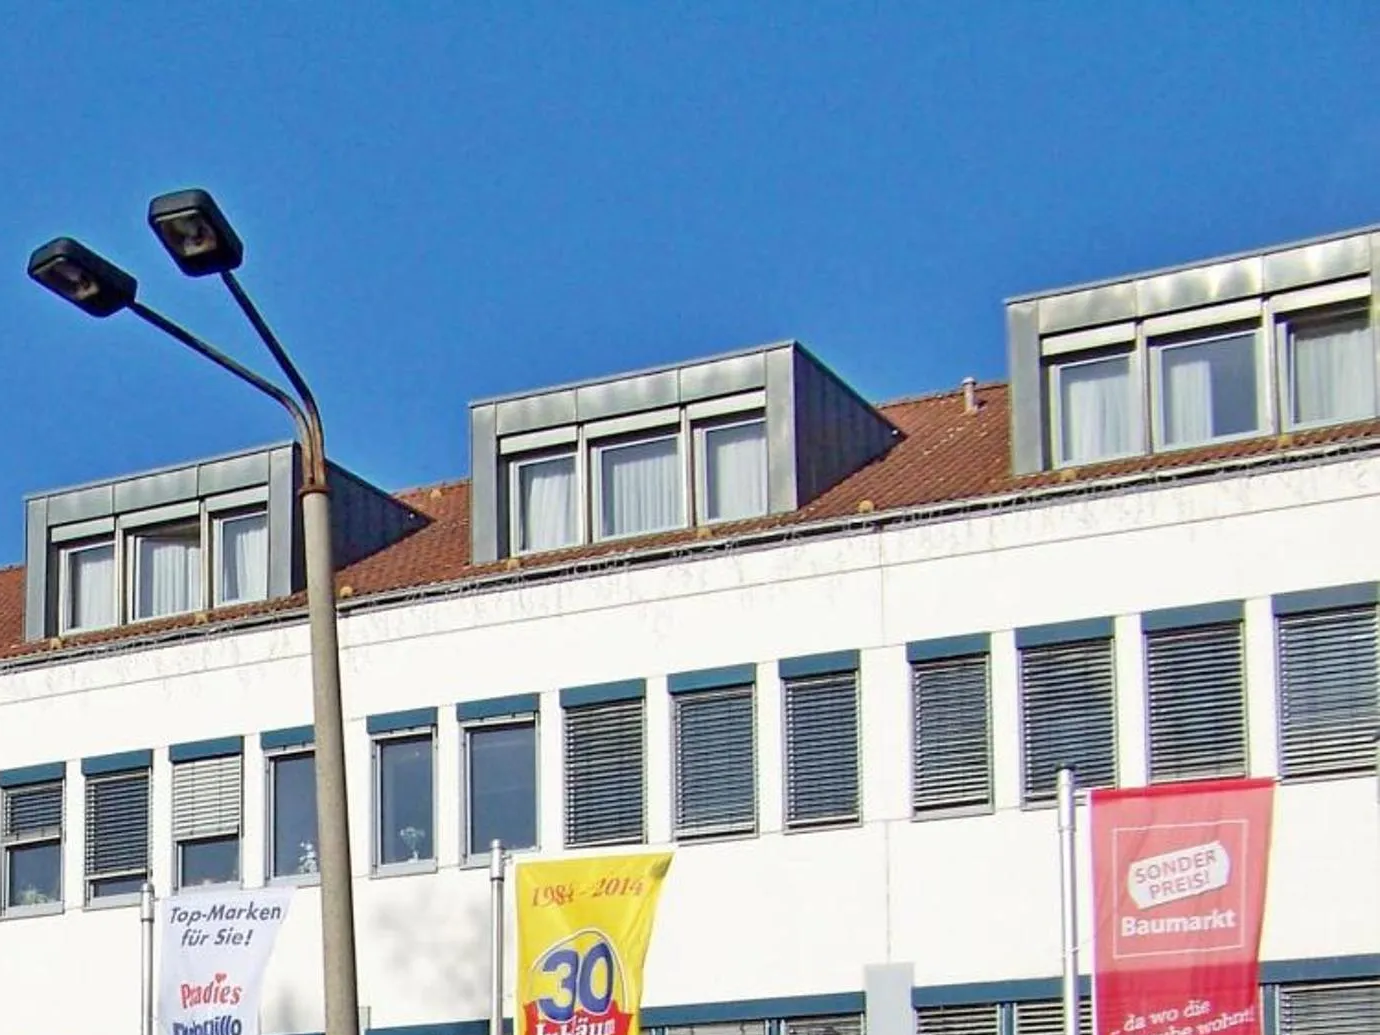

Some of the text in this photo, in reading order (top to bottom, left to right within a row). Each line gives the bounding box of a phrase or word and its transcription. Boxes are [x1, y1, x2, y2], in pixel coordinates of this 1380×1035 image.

[1134, 850, 1217, 884] SONDER
[592, 876, 644, 898] 2014
[1148, 870, 1210, 899] PREIS!
[170, 901, 282, 927] Top-Marken
[1121, 908, 1237, 937] Baumarkt
[181, 928, 255, 947] für Sie!
[537, 942, 614, 1022] 30
[1124, 1013, 1146, 1032] da
[1149, 1006, 1179, 1025] wo
[1183, 999, 1211, 1018] die
